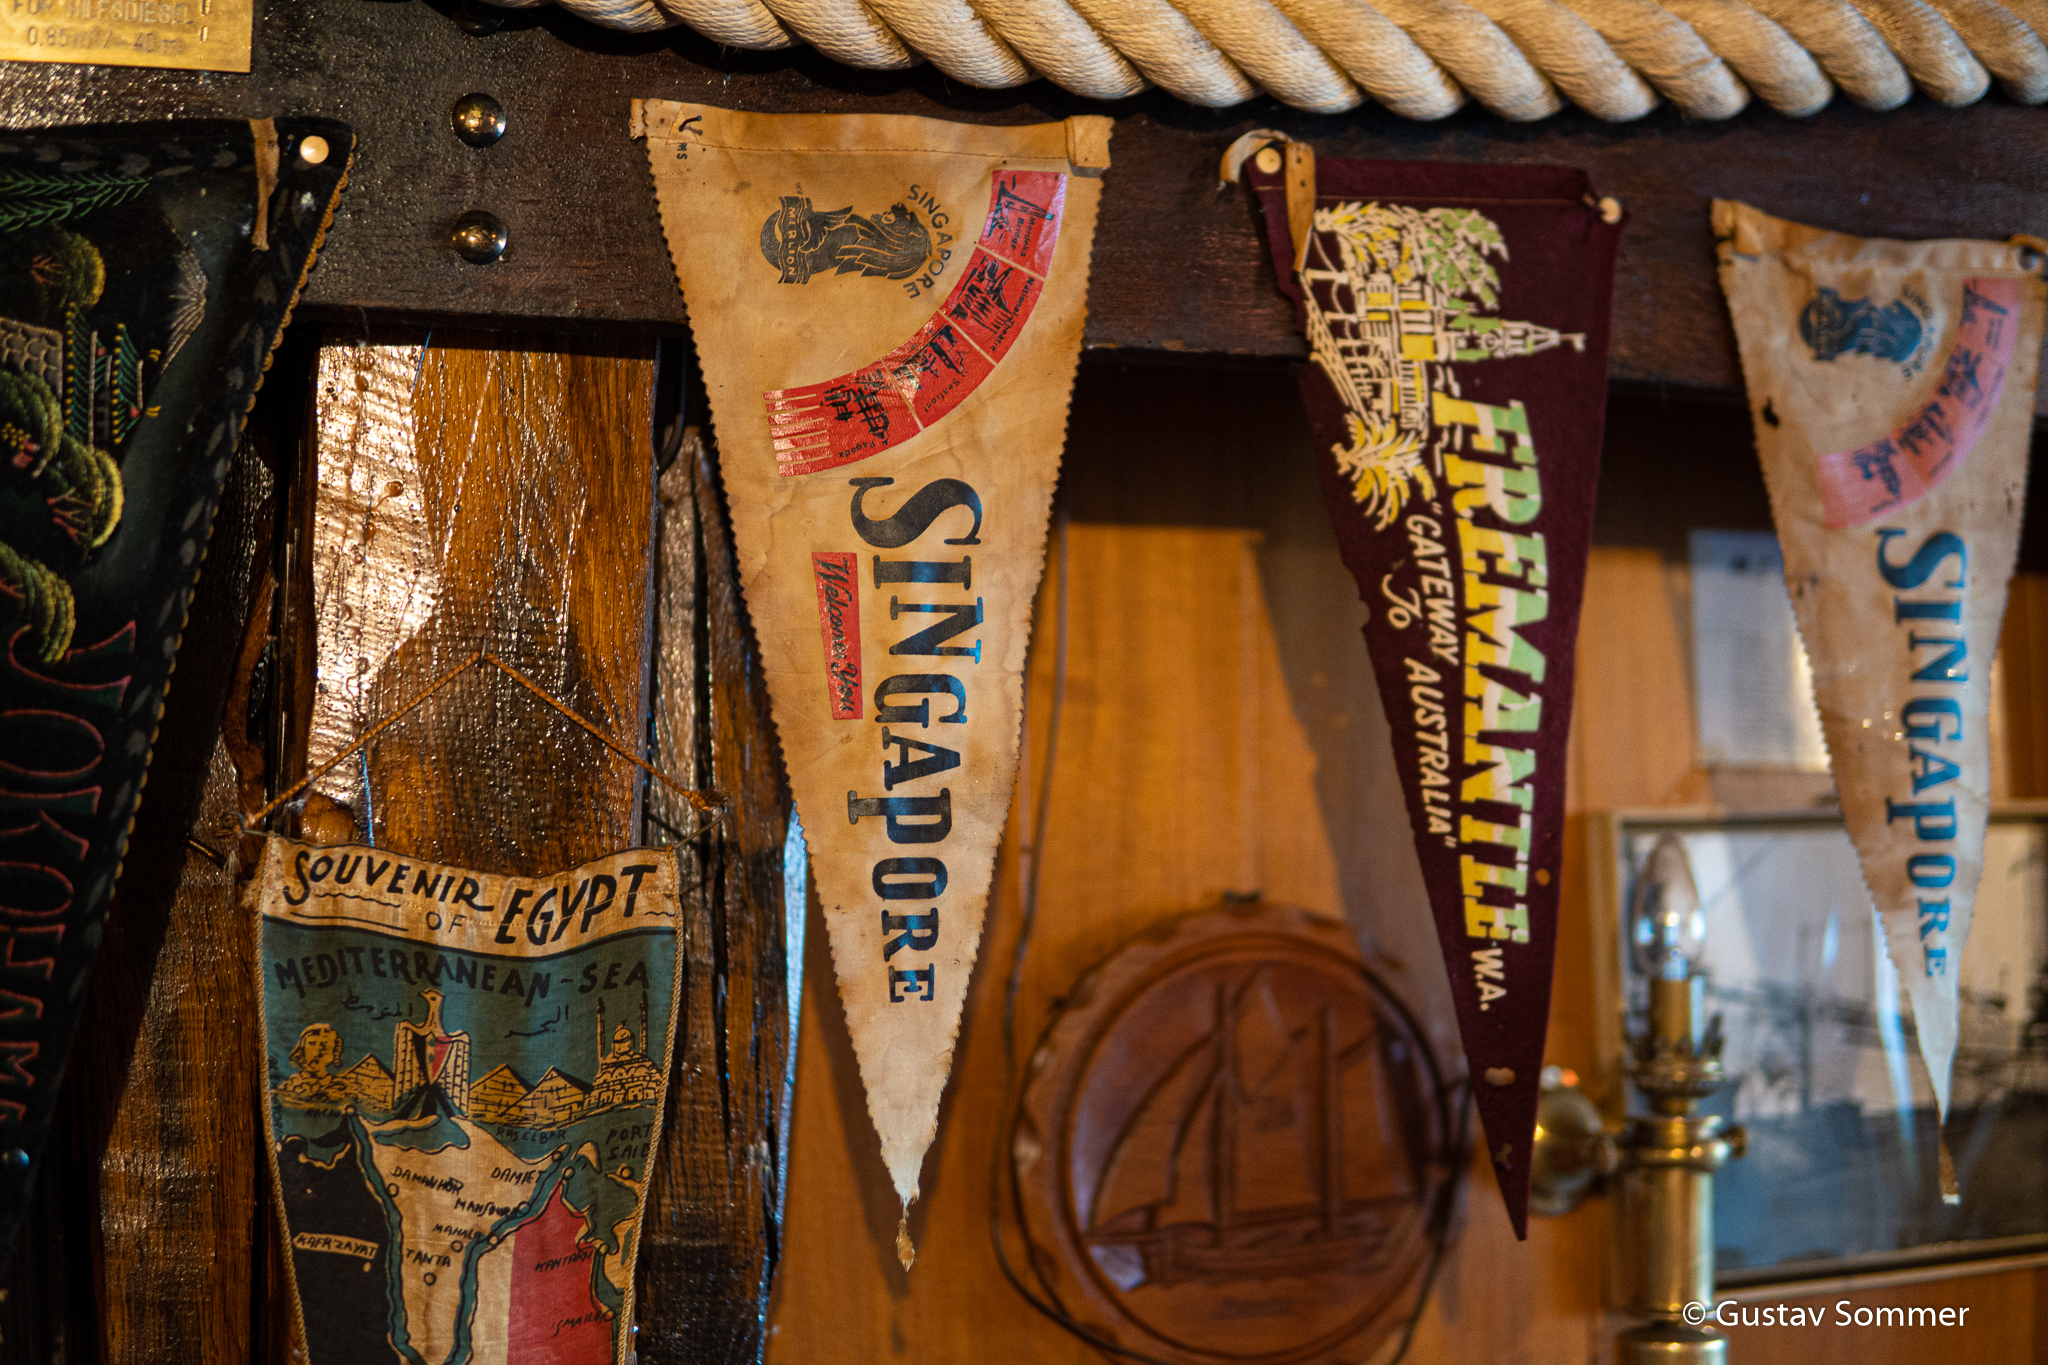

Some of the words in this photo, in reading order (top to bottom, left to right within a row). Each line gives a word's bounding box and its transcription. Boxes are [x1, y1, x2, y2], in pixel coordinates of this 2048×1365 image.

[786, 206, 799, 277] MERLION
[902, 183, 953, 300] SINGAPORE
[1008, 217, 1025, 251] Bridge
[1019, 216, 1038, 259] Merdeka
[1011, 276, 1036, 319] National
[989, 317, 1017, 353] Theatre
[924, 378, 960, 414] Seafront
[838, 440, 876, 458] Pagoda
[815, 557, 853, 660] Welcomes
[830, 662, 859, 712] You
[1431, 391, 1548, 944] FREMANTLE
[847, 477, 984, 1004] SINGAPORE
[1876, 527, 1969, 977] SINGAPORE
[282, 850, 495, 912] SOUVENIR
[426, 911, 467, 934] OF
[494, 864, 658, 946] EGYPT
[606, 1123, 654, 1145] PORT
[297, 1234, 332, 1250] KAFR
[334, 1239, 377, 1257] ZAYAT
[406, 1248, 451, 1268] TANTA
